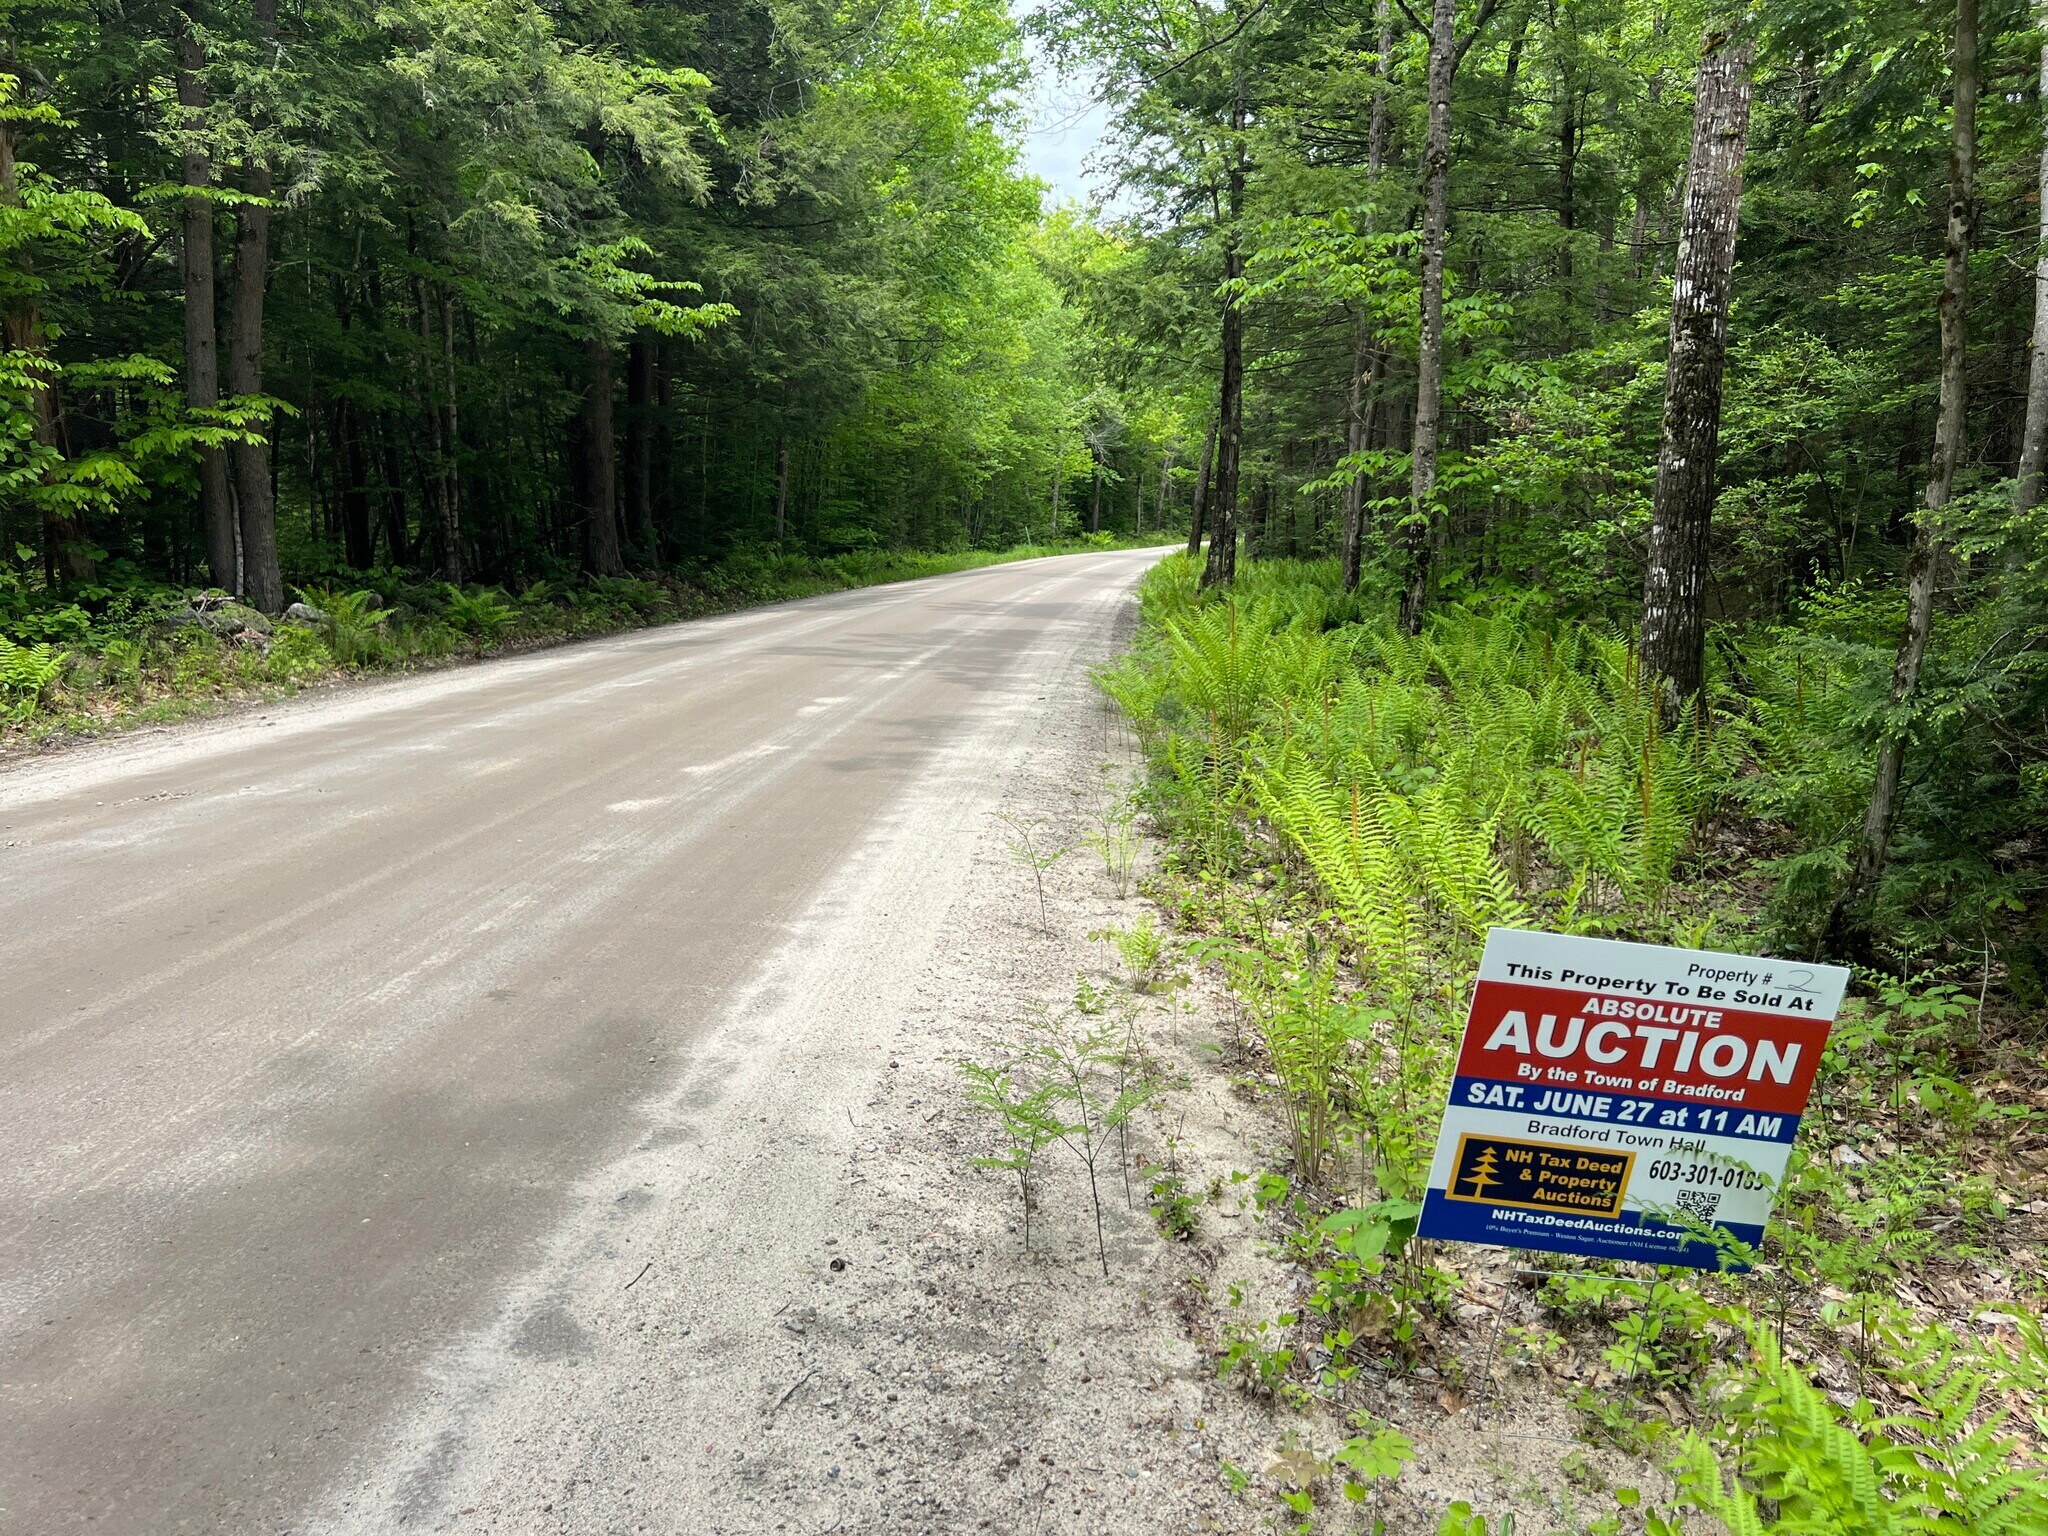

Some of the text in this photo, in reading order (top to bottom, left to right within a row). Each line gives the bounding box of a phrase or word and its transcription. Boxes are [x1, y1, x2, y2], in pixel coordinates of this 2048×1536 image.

[1506, 963, 1814, 1011] This Property To Be Sold At
[1687, 963, 1773, 987] Property #
[1787, 969, 1814, 992] 2
[1581, 997, 1723, 1029] ABSOLUTE
[1482, 1010, 1802, 1085] AUCTION
[1517, 1062, 1746, 1102] By the Town of Bradford
[1467, 1082, 1783, 1138] SAT. JUNE 27 at 11 AM
[1527, 1120, 1706, 1152] Bradford Town Hall
[1505, 1149, 1623, 1174] NH Tax Deed
[1519, 1168, 1617, 1192] & Property
[1532, 1187, 1612, 1208] Auctions
